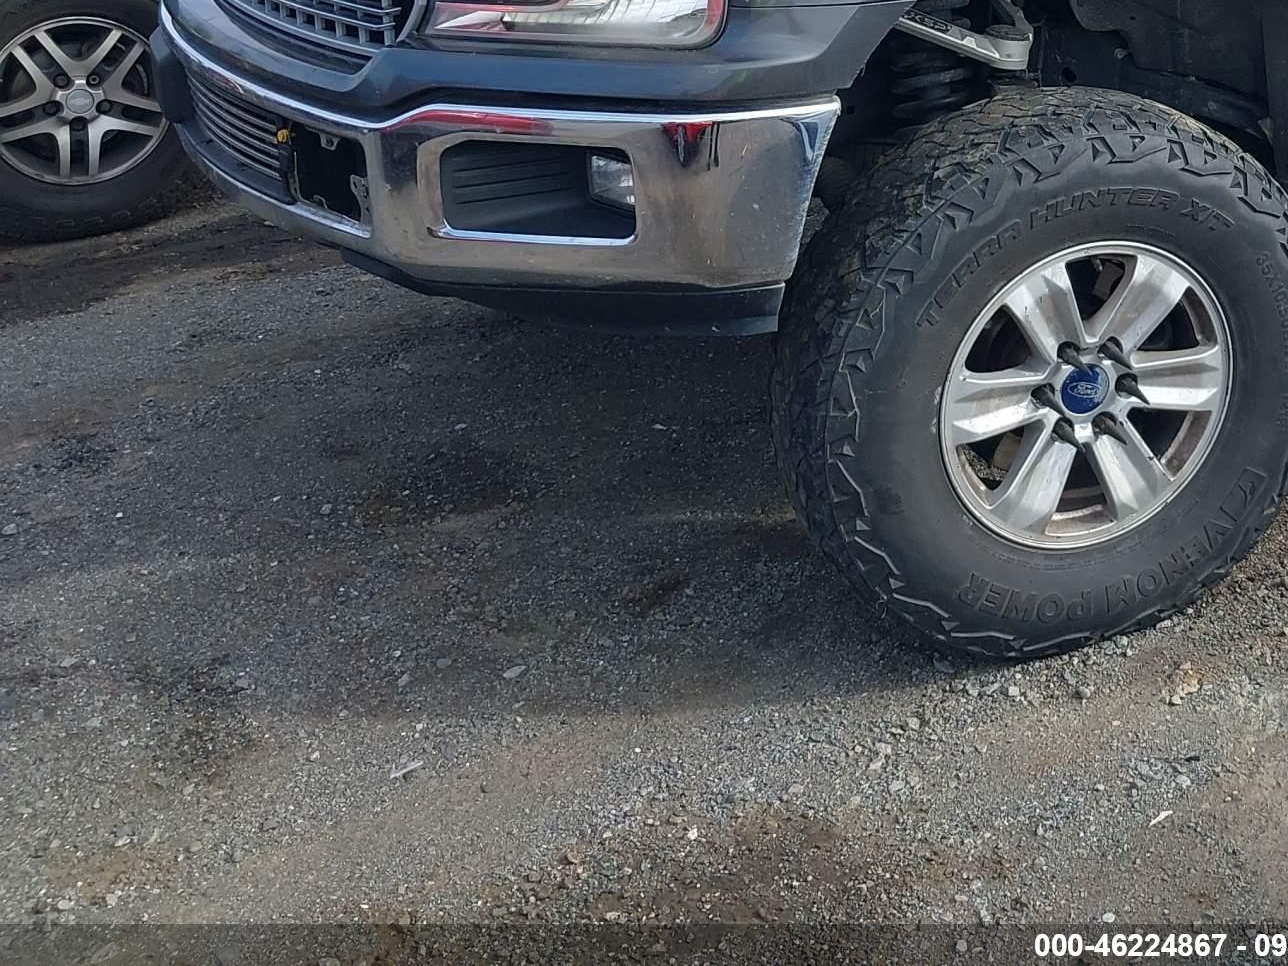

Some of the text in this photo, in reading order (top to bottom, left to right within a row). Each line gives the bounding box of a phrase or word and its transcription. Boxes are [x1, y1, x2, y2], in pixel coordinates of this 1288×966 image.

[915, 219, 1022, 328] TERRA
[1029, 186, 1182, 230] HUNTER
[956, 571, 1095, 624] POWER
